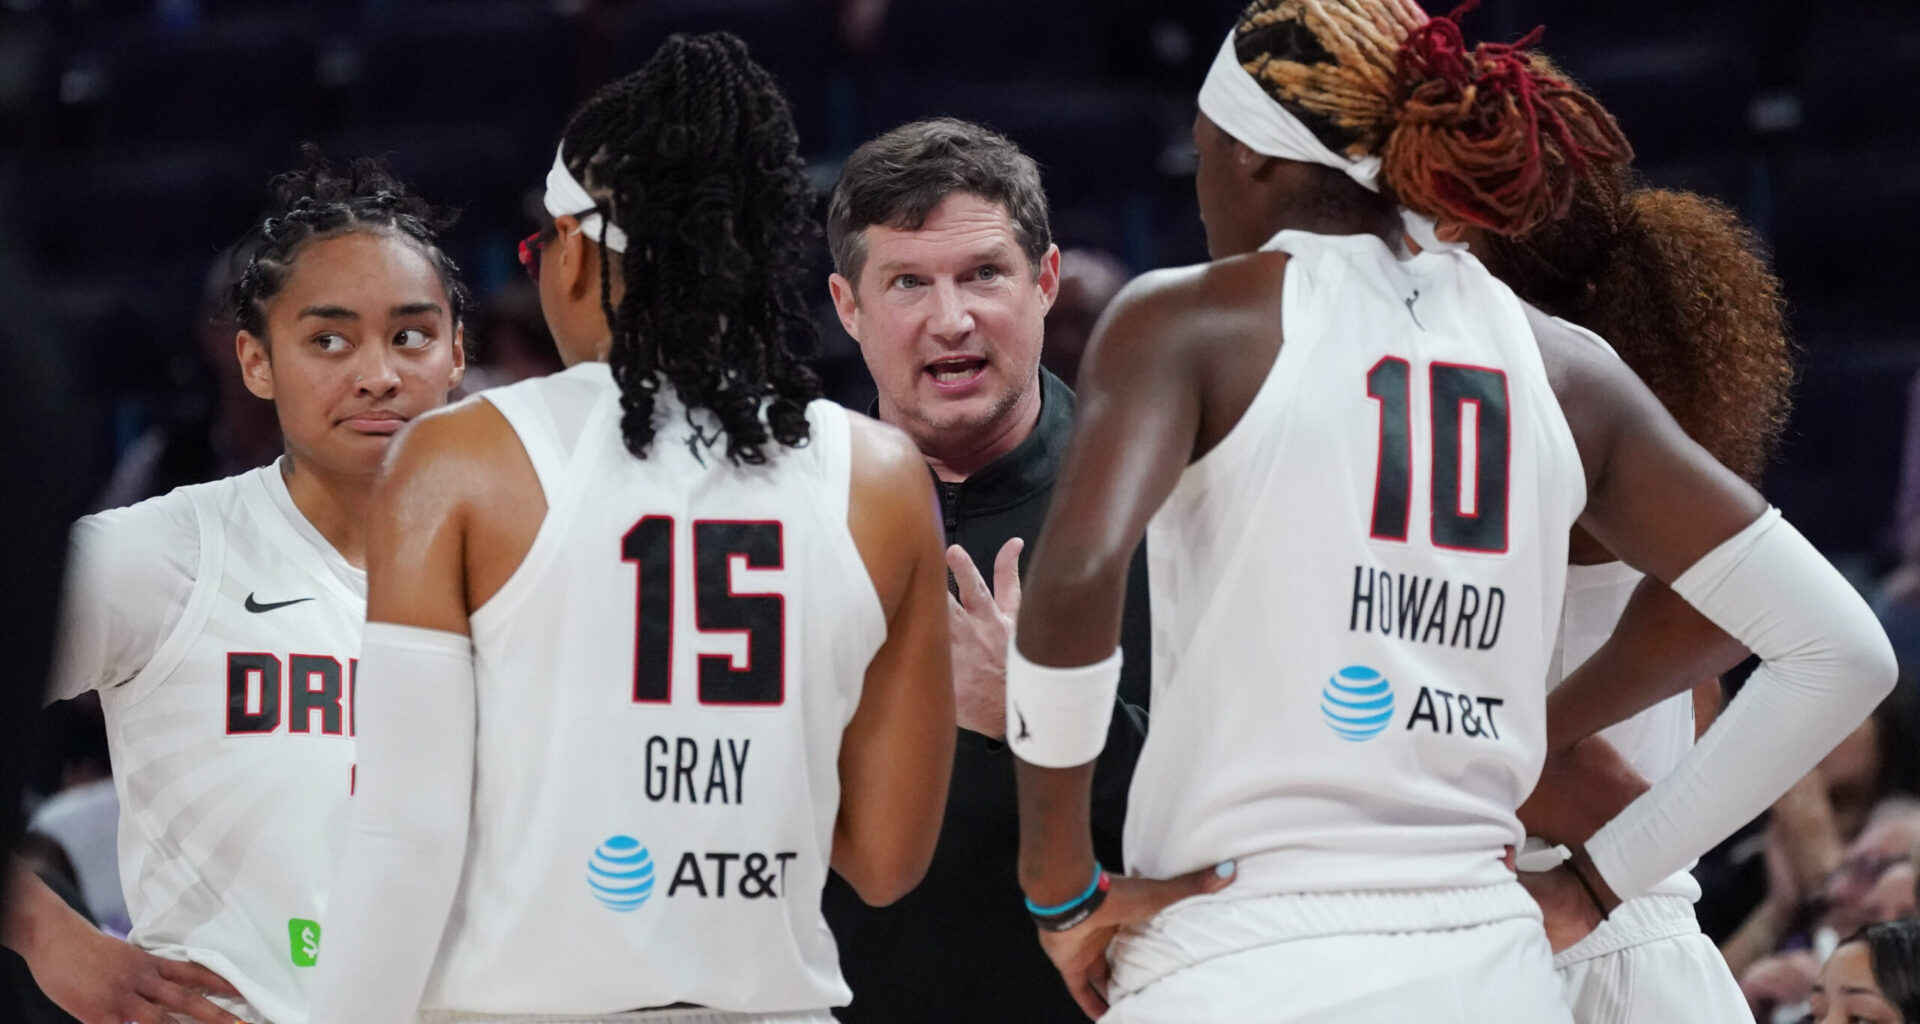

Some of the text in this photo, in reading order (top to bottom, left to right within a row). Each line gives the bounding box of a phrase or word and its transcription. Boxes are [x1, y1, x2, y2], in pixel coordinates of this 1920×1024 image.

[1366, 355, 1511, 555] 10
[620, 515, 785, 706] 15
[1350, 565, 1506, 651] HOWARD
[226, 651, 359, 737] DR
[1406, 686, 1505, 740] AT&T
[645, 735, 751, 805] GRAY
[667, 852, 798, 900] AT&T
